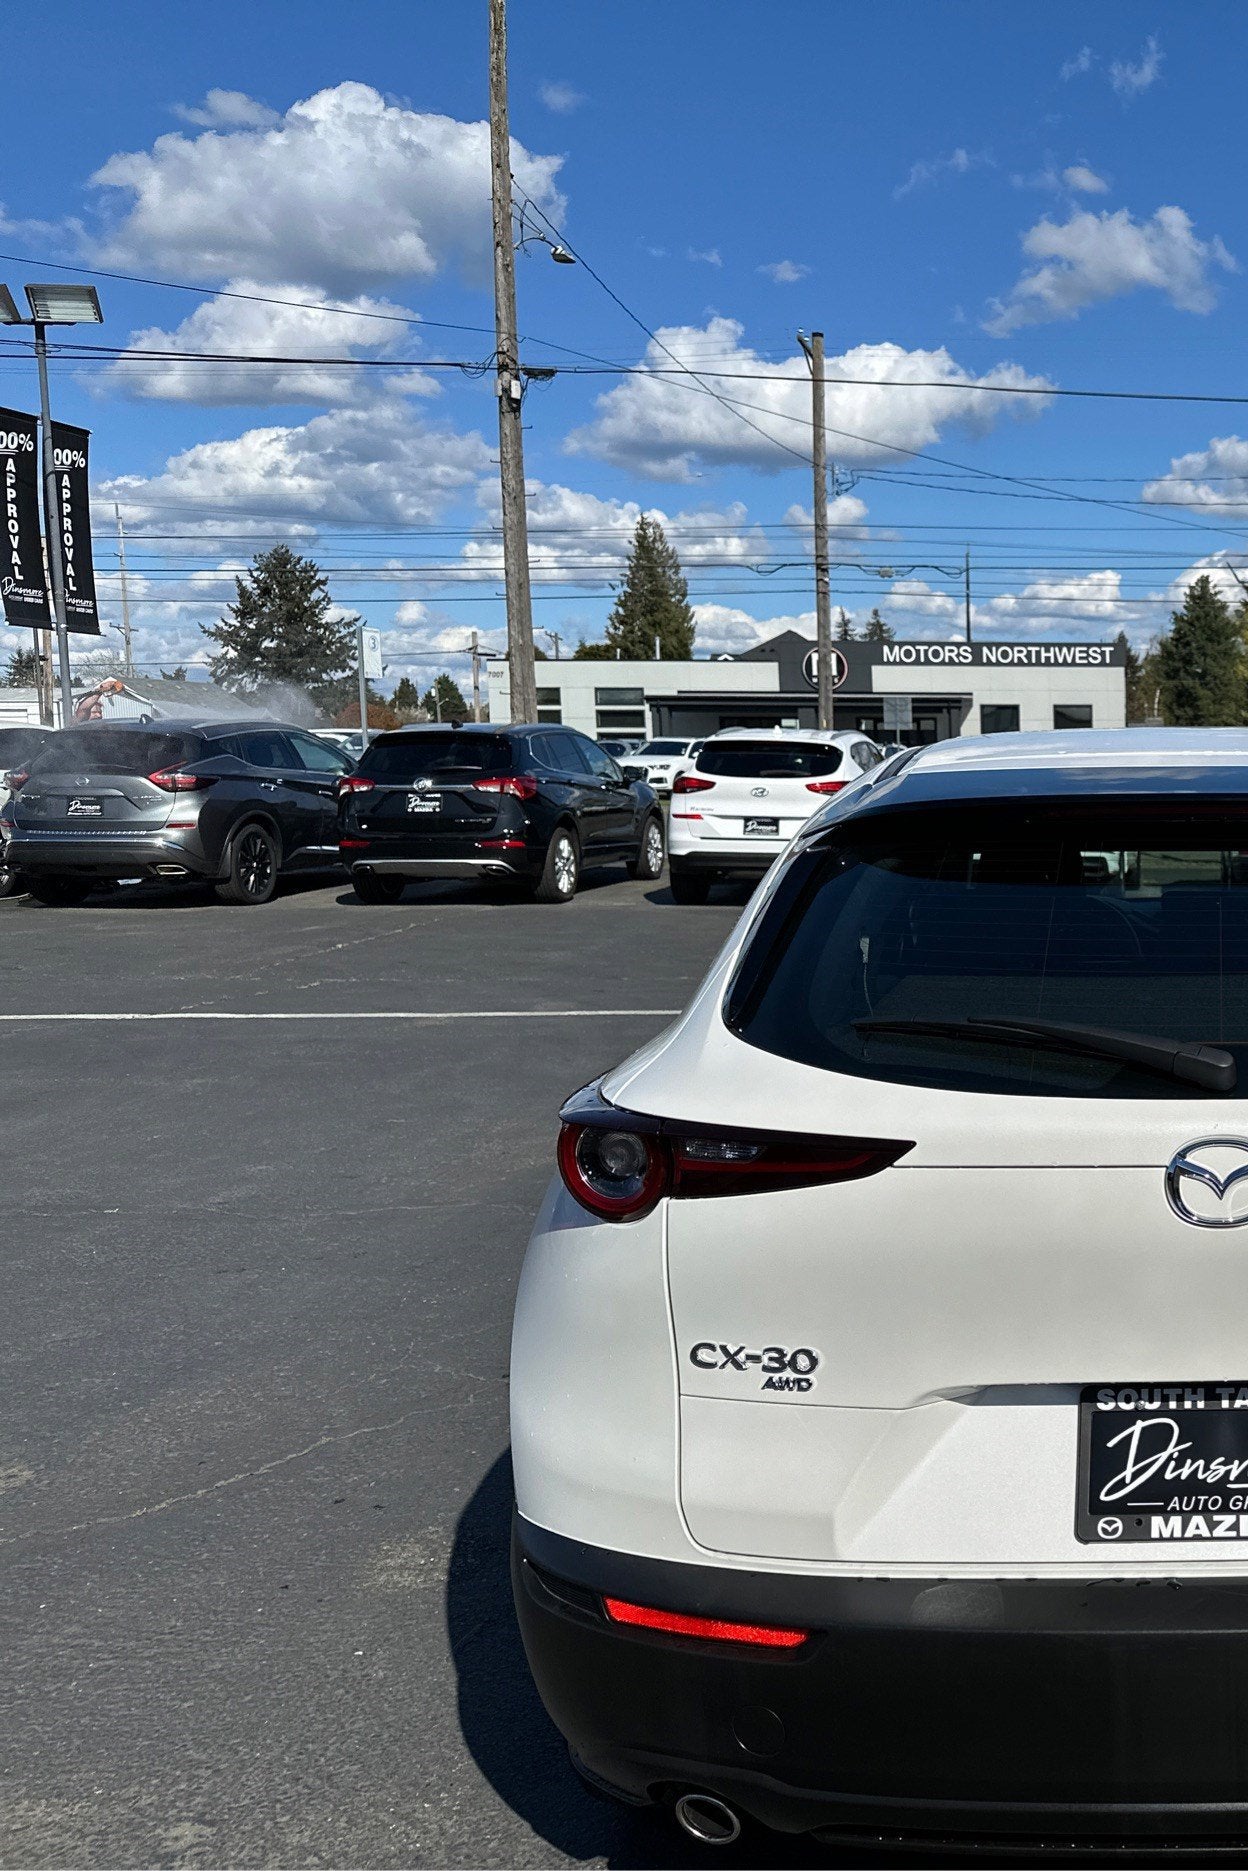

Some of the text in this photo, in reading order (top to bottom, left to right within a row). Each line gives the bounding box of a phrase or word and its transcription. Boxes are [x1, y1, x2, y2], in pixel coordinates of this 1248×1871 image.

[0, 430, 34, 452] 00%
[53, 447, 86, 468] 00%
[5, 457, 24, 581] APPROVAL
[61, 473, 77, 592] APPROVAL
[882, 644, 1115, 664] MOTORS NORTHWEST
[689, 1341, 819, 1376] CX-30
[761, 1376, 813, 1392] AWD
[1096, 1387, 1205, 1411] SOUTH
[1167, 1495, 1224, 1511] AUTO
